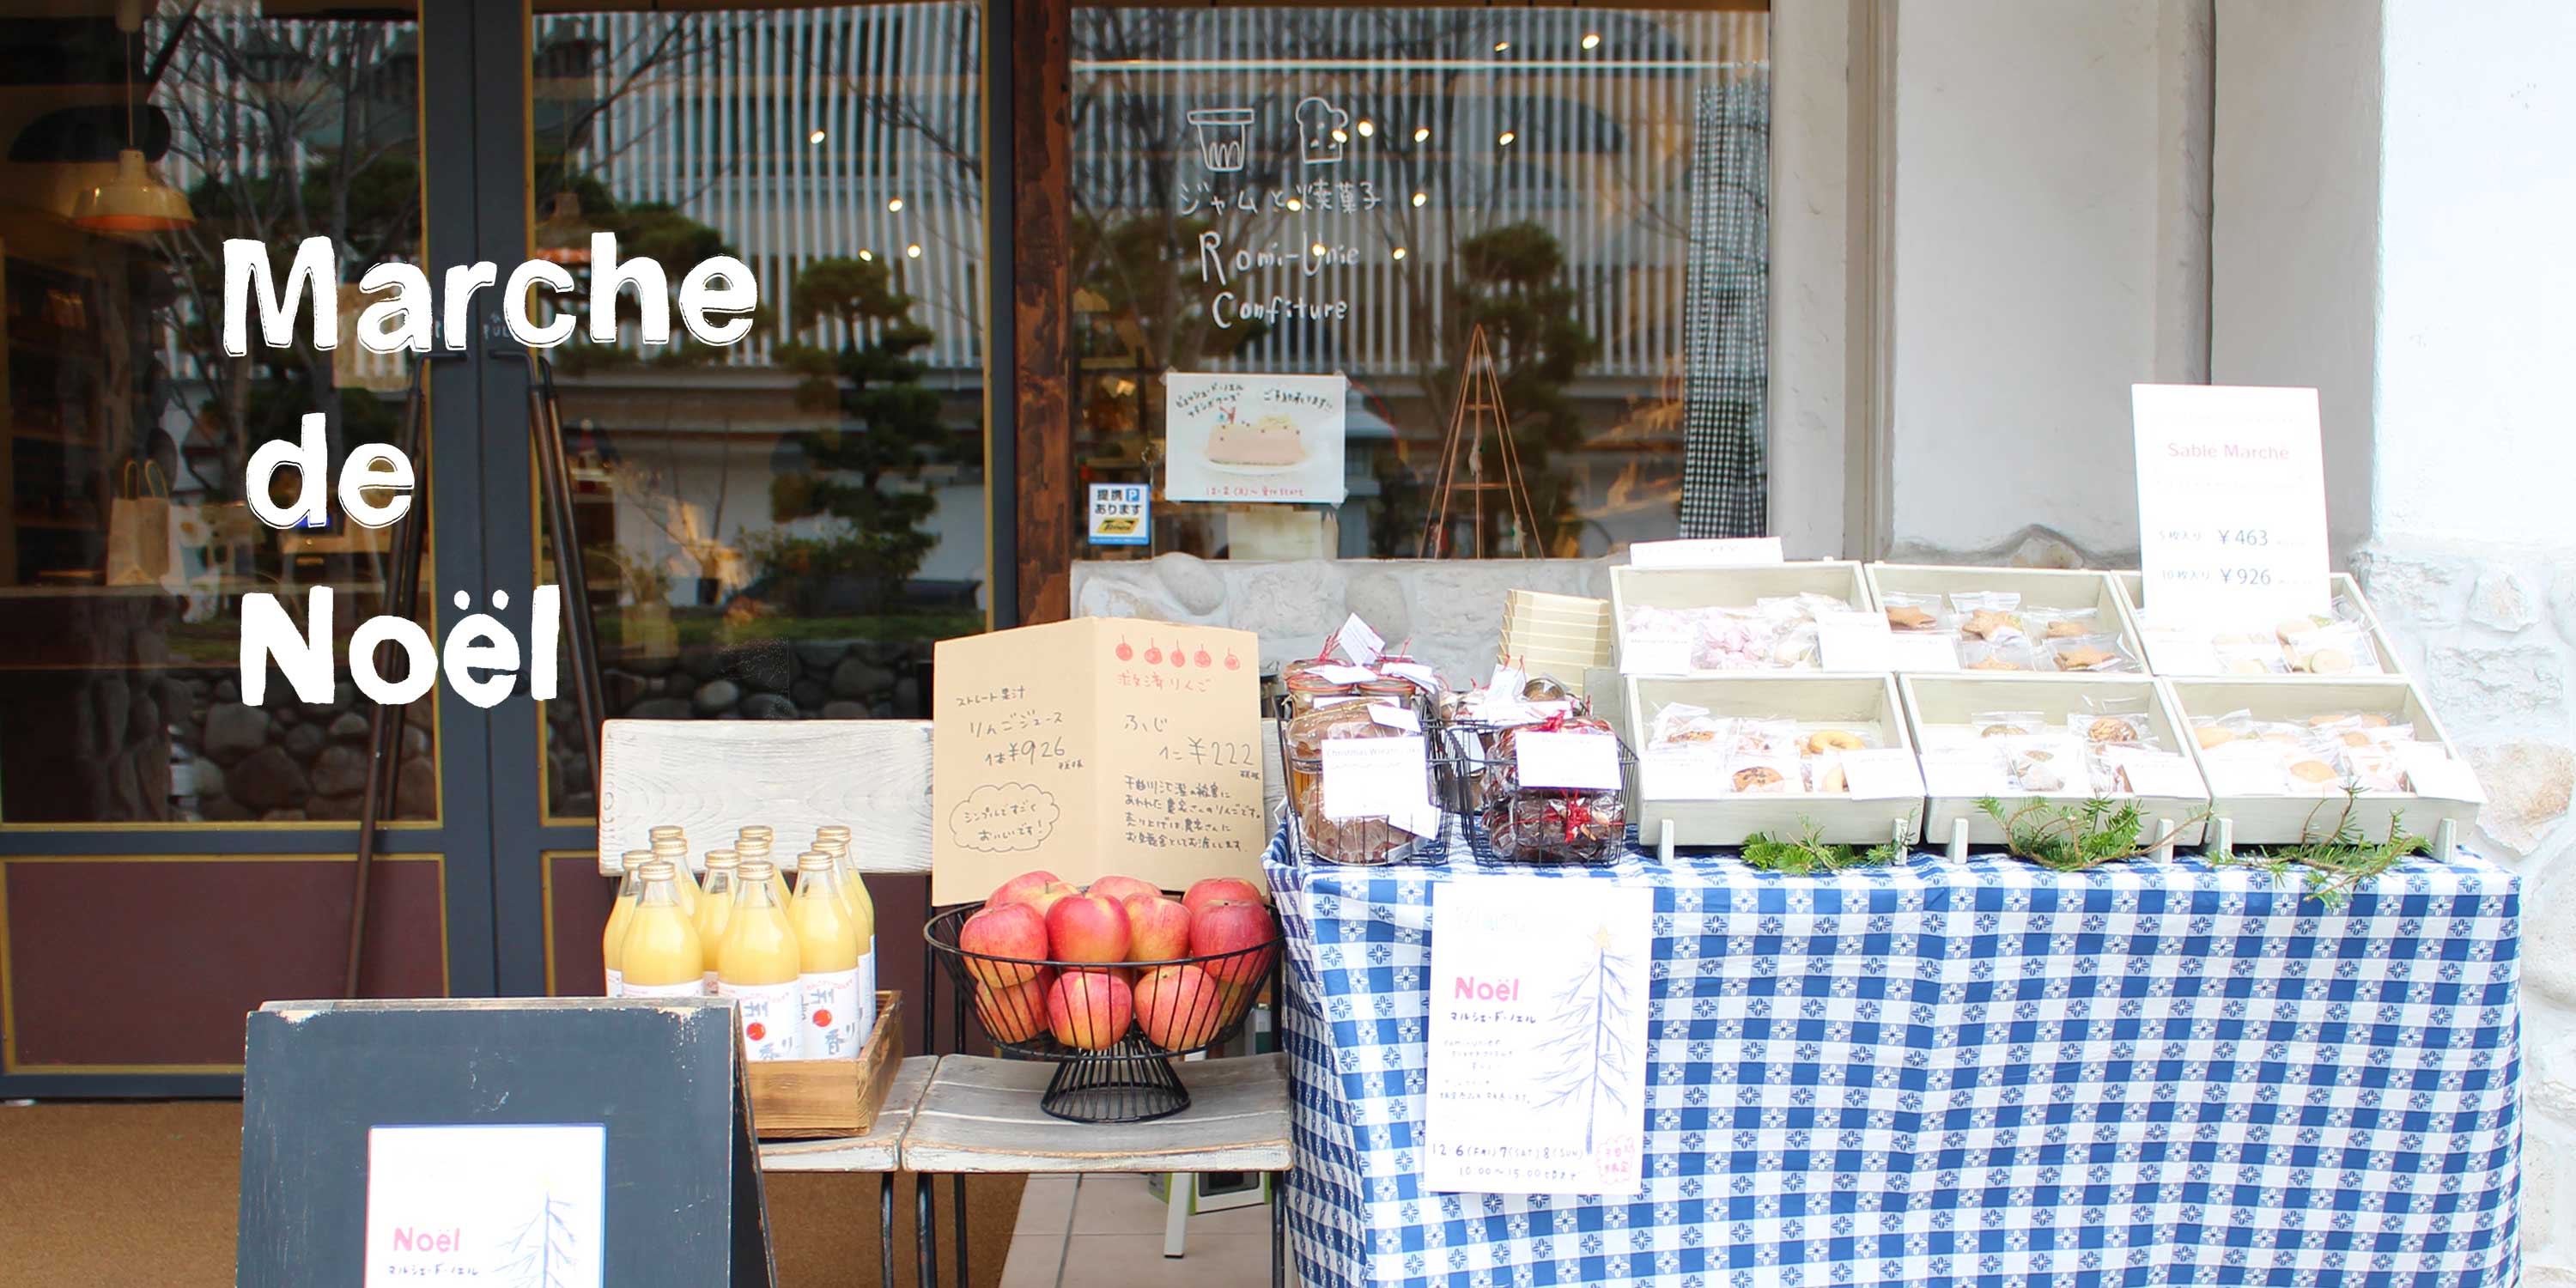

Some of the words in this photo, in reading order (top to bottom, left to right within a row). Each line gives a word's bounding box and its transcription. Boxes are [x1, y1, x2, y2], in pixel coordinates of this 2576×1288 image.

[1212, 291, 1349, 329] Confiture
[1095, 503, 1142, 516] あります
[969, 709, 1064, 738] りんごジュース
[1454, 975, 1521, 1002] Noël
[392, 1225, 461, 1254] Noël
